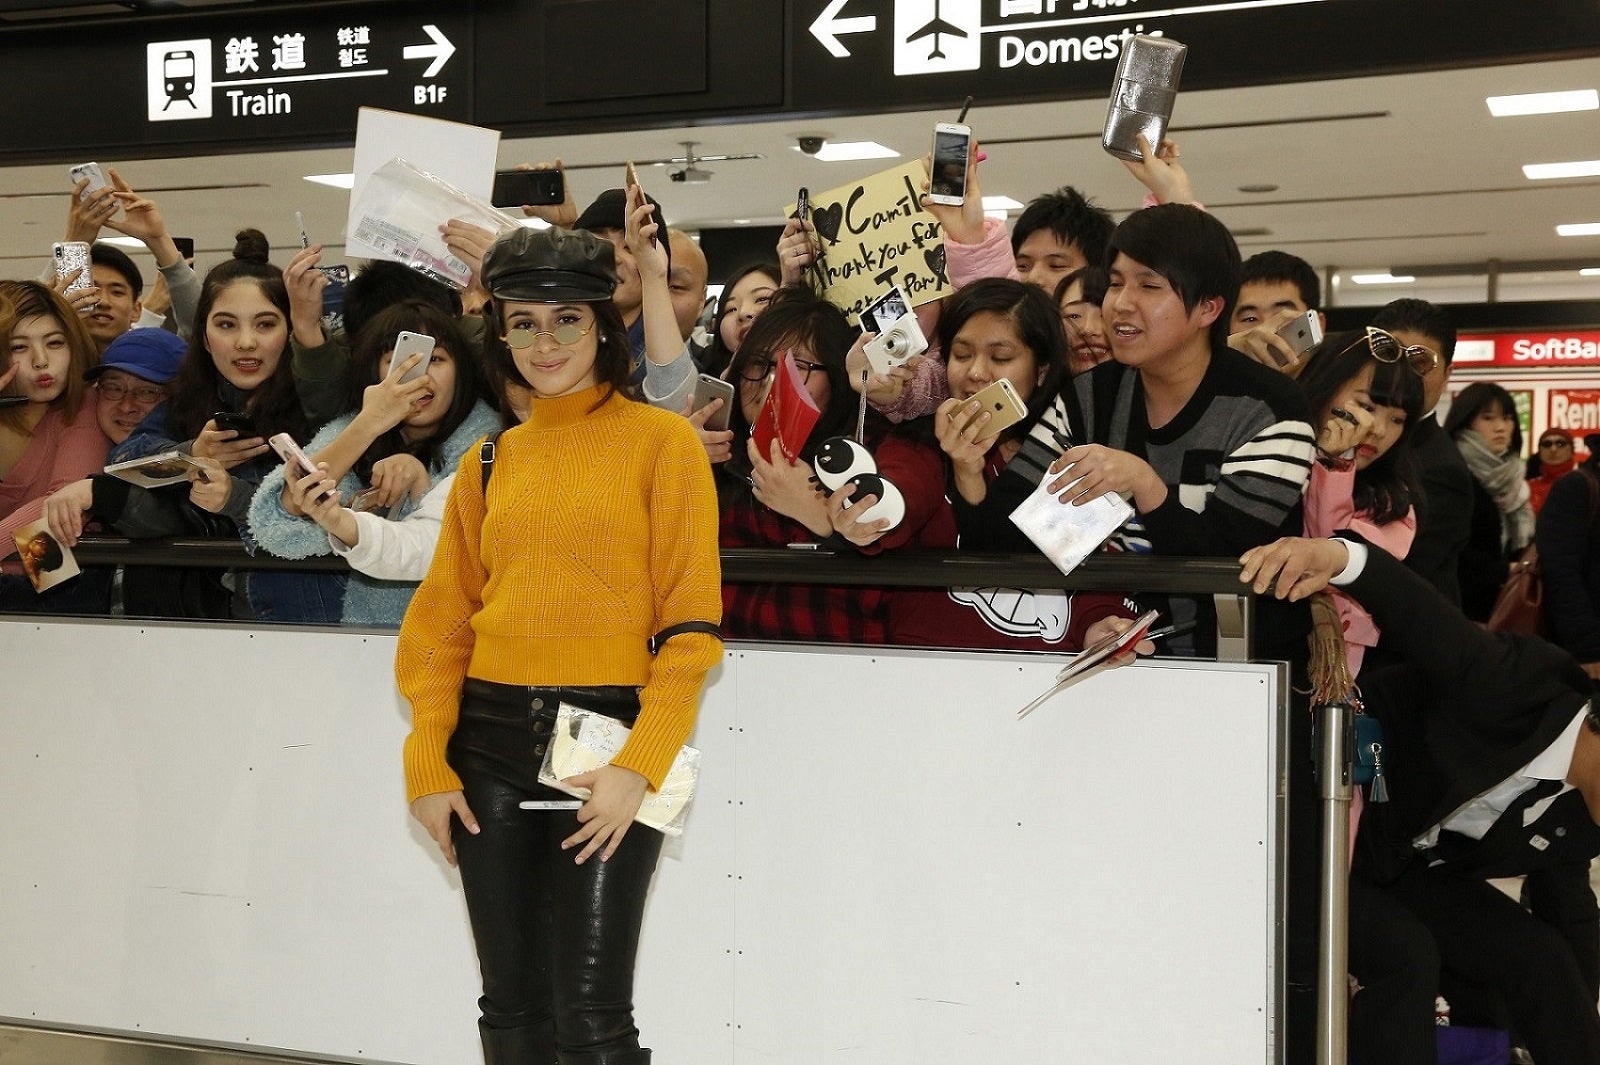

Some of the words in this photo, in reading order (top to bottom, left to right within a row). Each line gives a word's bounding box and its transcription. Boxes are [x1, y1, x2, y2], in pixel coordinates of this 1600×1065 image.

[224, 32, 307, 74] 鉄道
[337, 48, 369, 68] 철도
[999, 24, 1164, 69] Domest
[226, 87, 291, 117] Train
[413, 85, 447, 105] B1F
[1512, 338, 1600, 361] SoftBa
